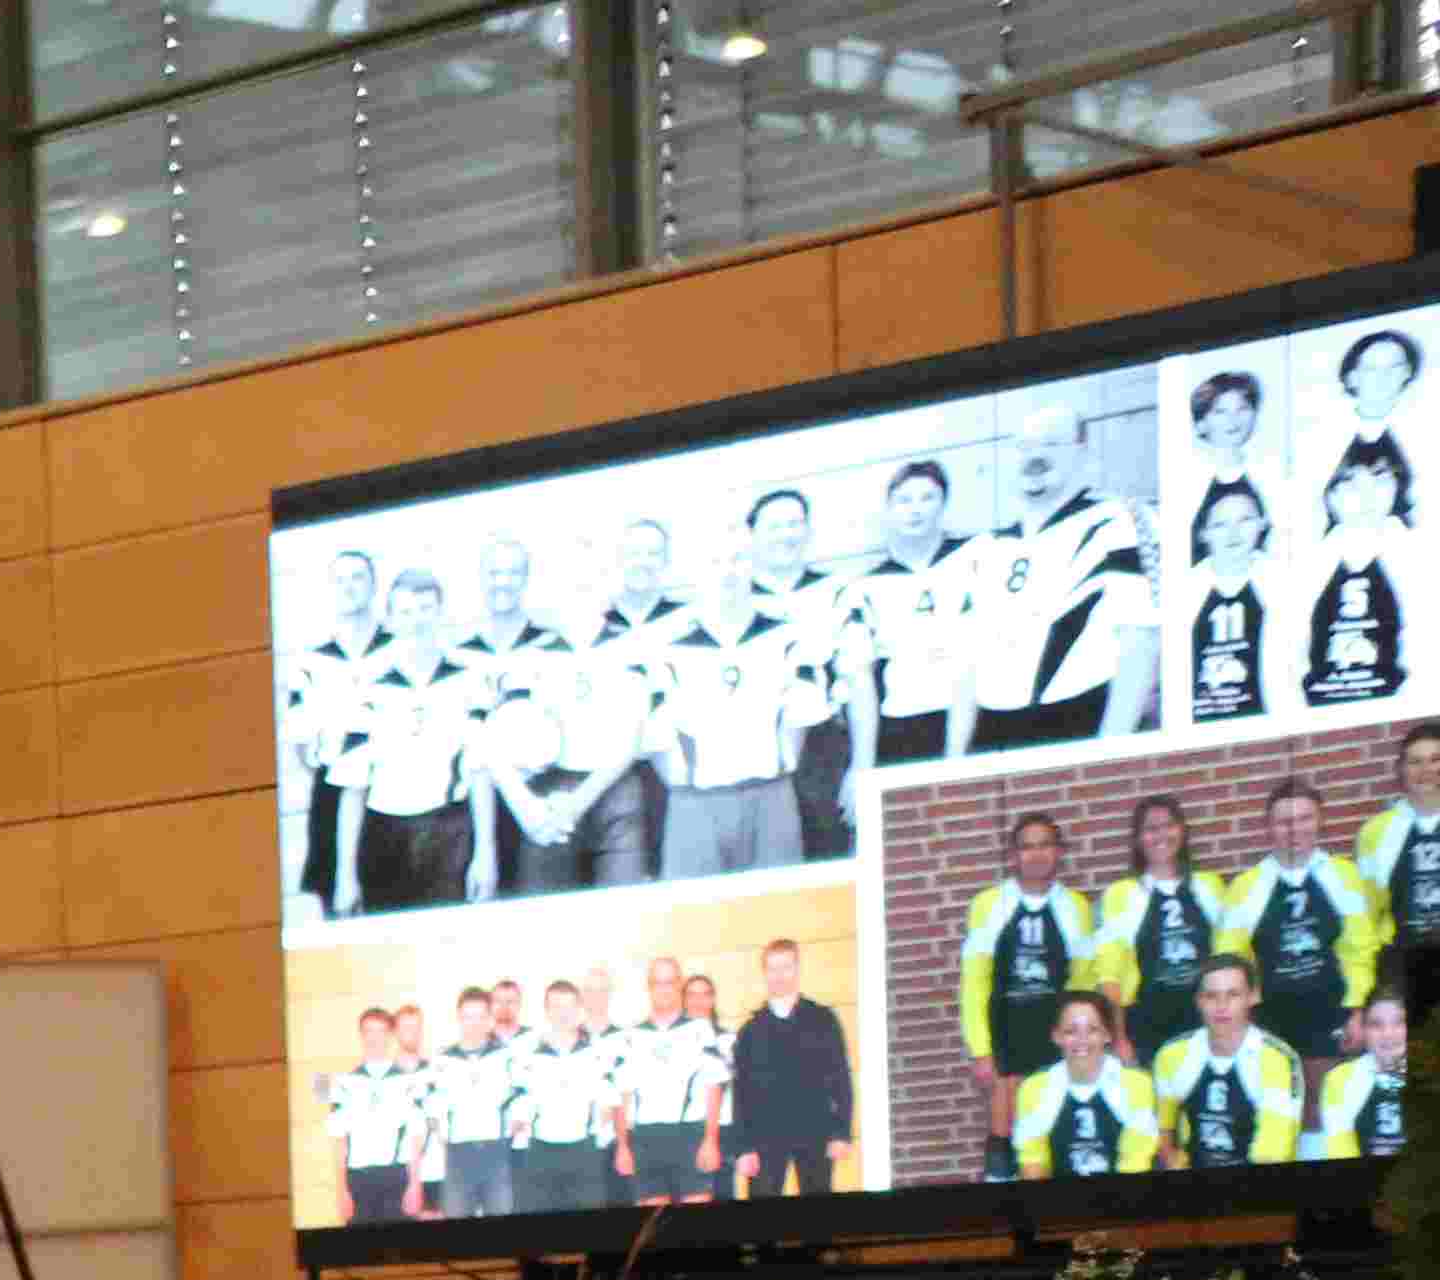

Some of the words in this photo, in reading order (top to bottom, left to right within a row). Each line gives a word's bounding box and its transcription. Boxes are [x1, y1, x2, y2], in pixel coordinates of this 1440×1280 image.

[1007, 558, 1030, 593] 8
[1208, 602, 1245, 641] 11
[1161, 899, 1182, 928] 2
[1018, 916, 1043, 945] 11
